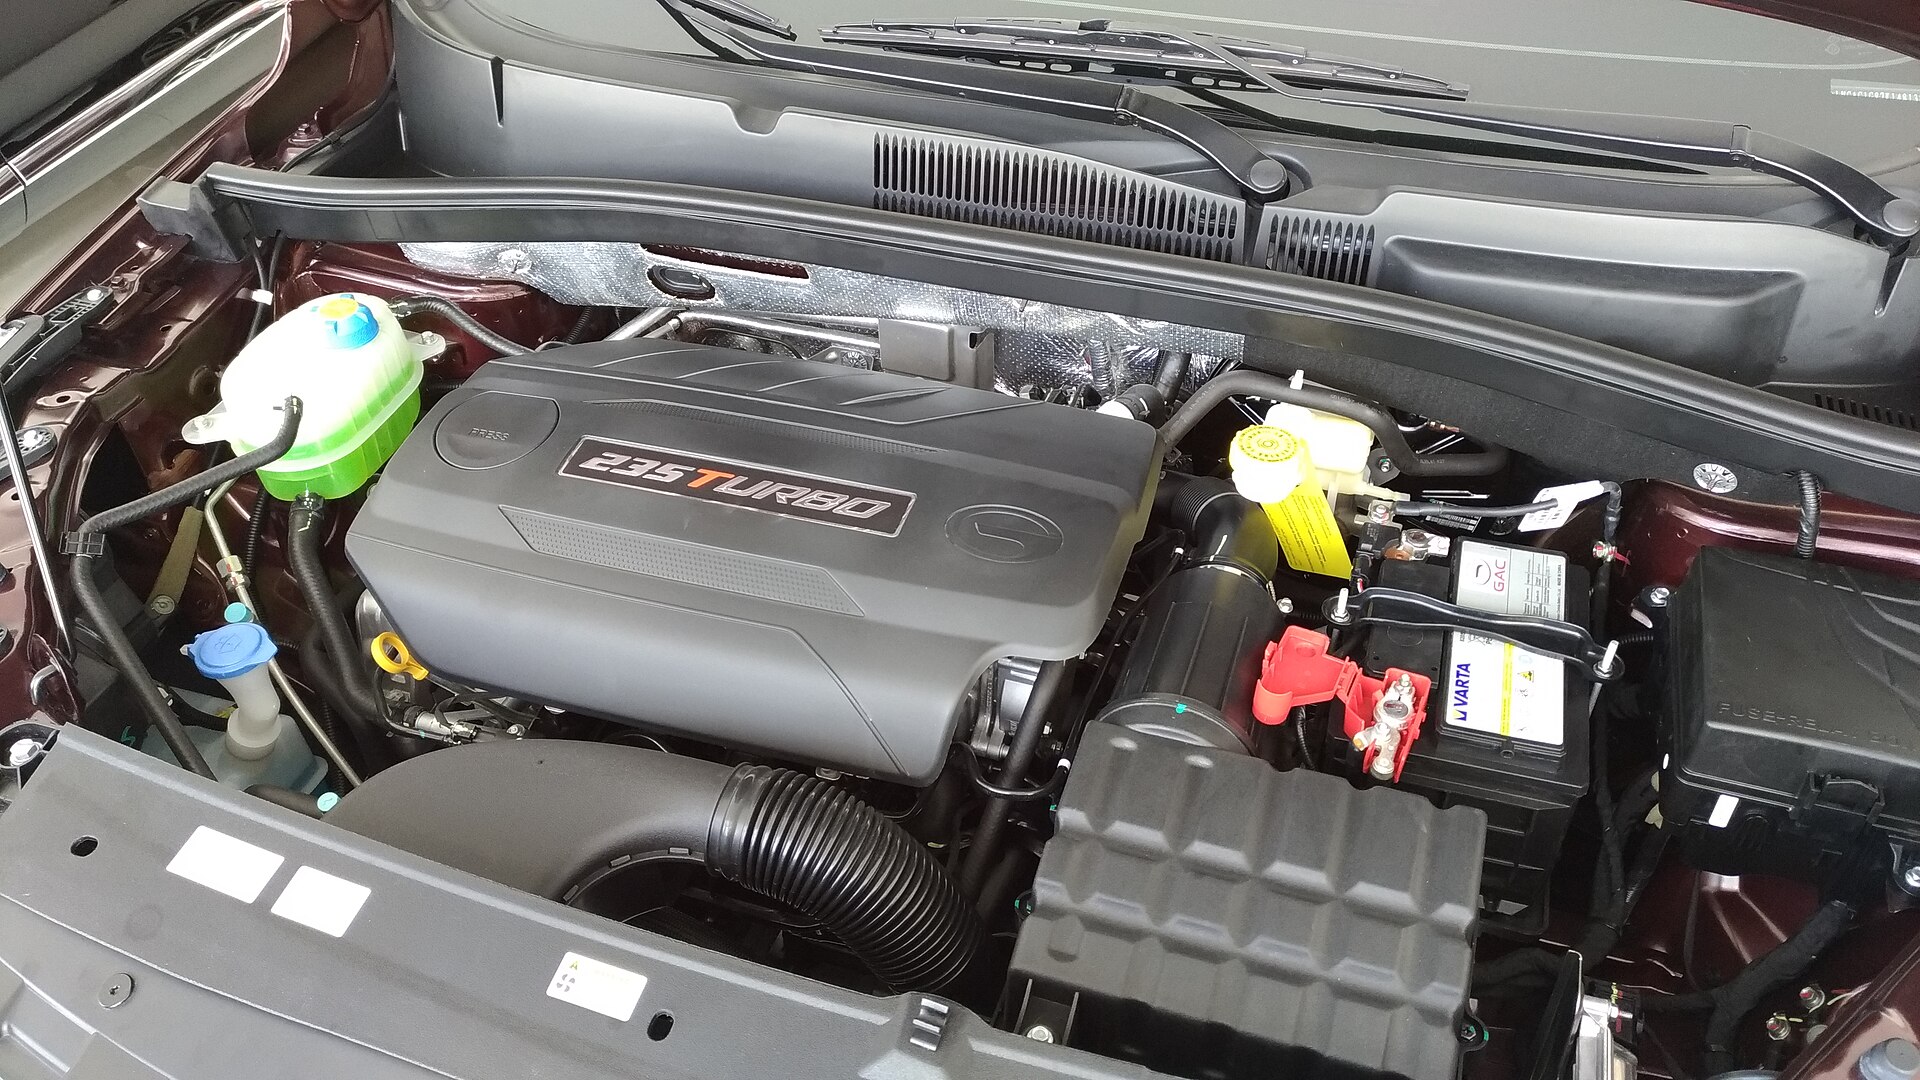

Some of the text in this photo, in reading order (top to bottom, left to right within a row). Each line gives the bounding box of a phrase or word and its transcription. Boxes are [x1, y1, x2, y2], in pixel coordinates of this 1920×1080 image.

[468, 427, 510, 441] PRESS
[1493, 559, 1507, 592] GAC
[1453, 663, 1471, 706] VARTA
[1719, 703, 1857, 739] FUSE-RELA
